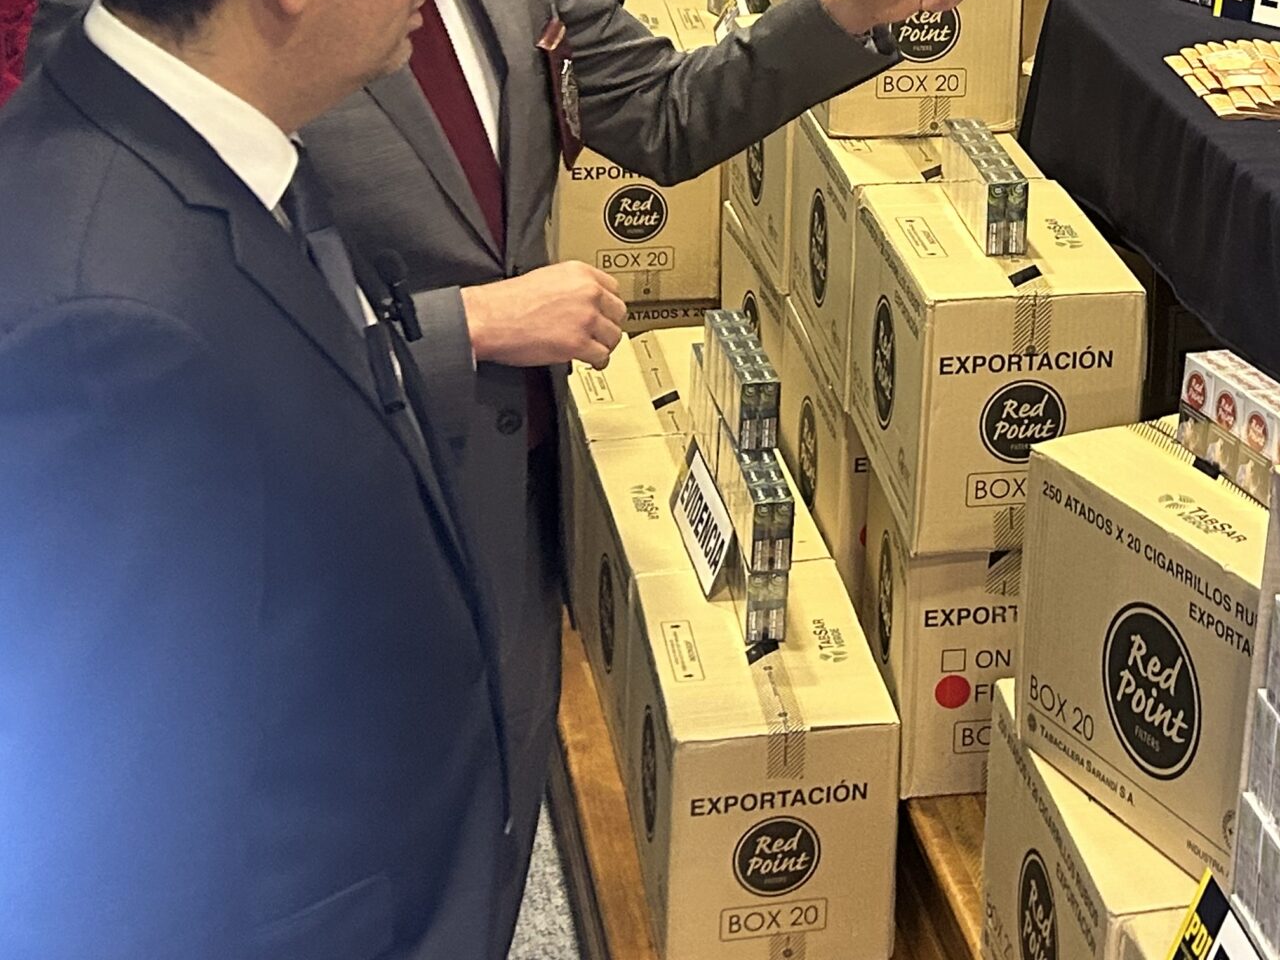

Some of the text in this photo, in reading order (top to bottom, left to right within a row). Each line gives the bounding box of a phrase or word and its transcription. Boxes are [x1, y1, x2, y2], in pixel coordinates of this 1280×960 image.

[899, 24, 951, 43] Point
[883, 74, 959, 93] BOX 20
[620, 195, 653, 210] Red
[614, 211, 659, 227] Point
[602, 252, 668, 268] BOX 20
[628, 308, 678, 320] ATADOS
[683, 309, 689, 317] X
[939, 346, 1113, 375] EXPORTACIÓN
[1002, 394, 1049, 419] Red
[993, 421, 1056, 440] Point
[975, 478, 1027, 499] BOX
[680, 471, 726, 576] EVIDENCIA
[1043, 480, 1232, 612] 250 ATADOS X 20 CIGARRILLOS
[1189, 602, 1252, 658] EXPORTA
[975, 649, 1011, 668] ON
[1127, 634, 1183, 696] Red
[1030, 675, 1067, 722] BOX
[1072, 707, 1094, 741] 20
[1116, 669, 1188, 744] Point
[1040, 724, 1084, 768] TABACALERA
[690, 780, 868, 817] EXPORTACIÓN
[756, 828, 802, 854] Red
[746, 855, 811, 876] Point
[728, 905, 818, 934] BOX 20
